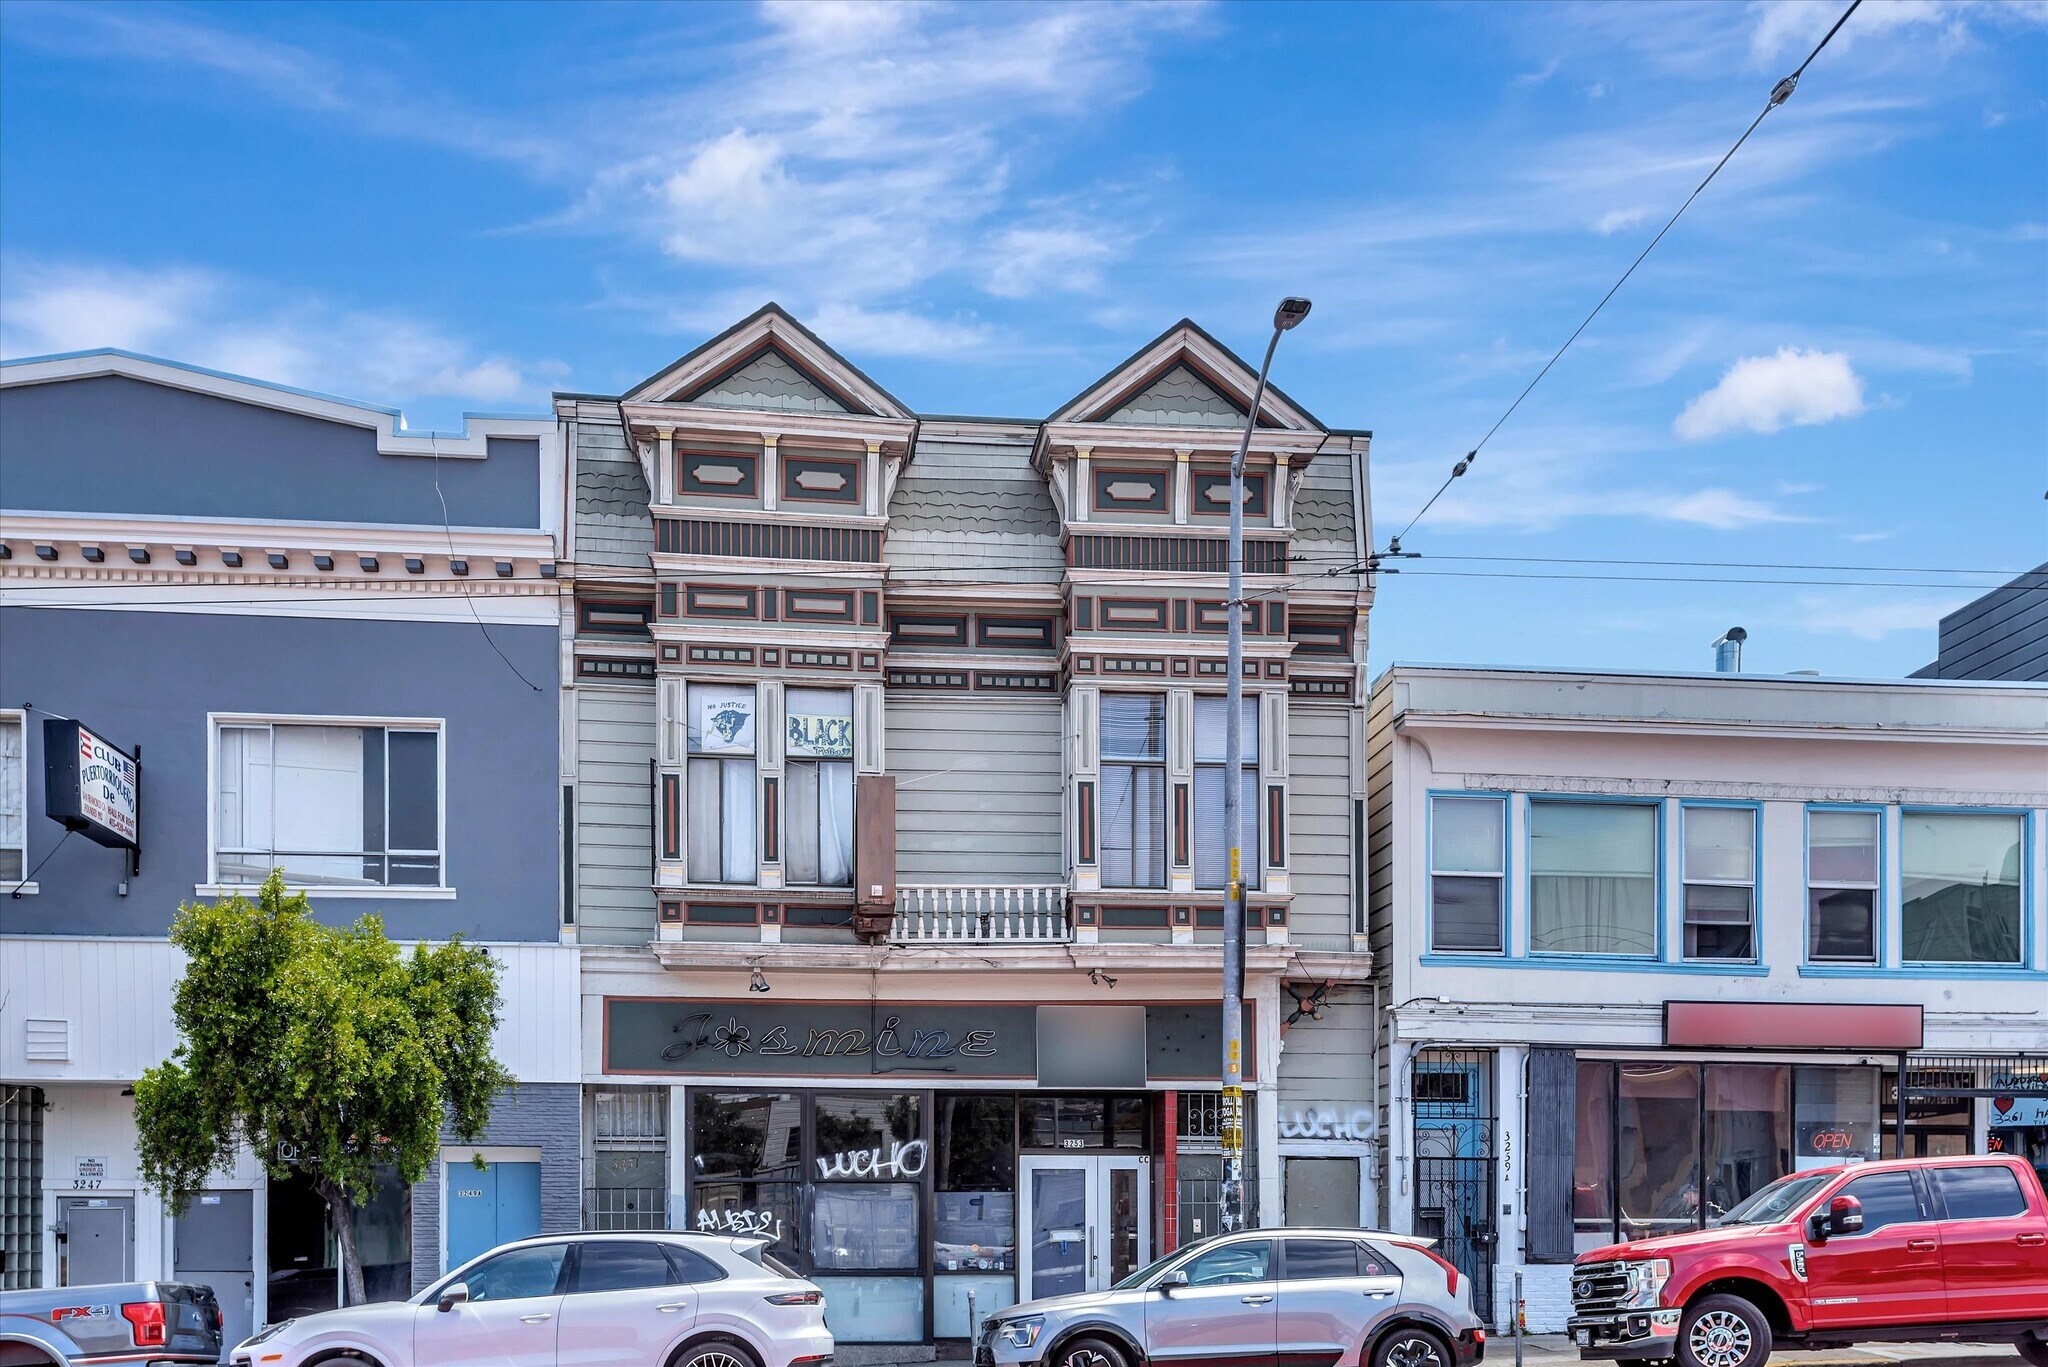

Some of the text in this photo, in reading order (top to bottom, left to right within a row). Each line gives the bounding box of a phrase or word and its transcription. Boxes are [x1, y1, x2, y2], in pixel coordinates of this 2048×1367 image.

[719, 701, 748, 709] JUSTICE
[788, 716, 852, 747] BLACK
[94, 745, 121, 772] CLUB
[81, 764, 135, 813] PUERTORRIQUEÑO
[103, 784, 115, 804] De
[107, 805, 135, 829] HALL FOR RENT
[662, 1013, 997, 1060] Jsmine
[1994, 1111, 2023, 1125] 3261
[1064, 1140, 1084, 1148] 3253
[1813, 1133, 1853, 1149] OPEN
[1988, 1139, 2003, 1151] EN
[816, 1139, 928, 1180] LUCHO
[1138, 1155, 1149, 1163] CC
[73, 1179, 101, 1189] 3247
[51, 1304, 110, 1322] FX4
